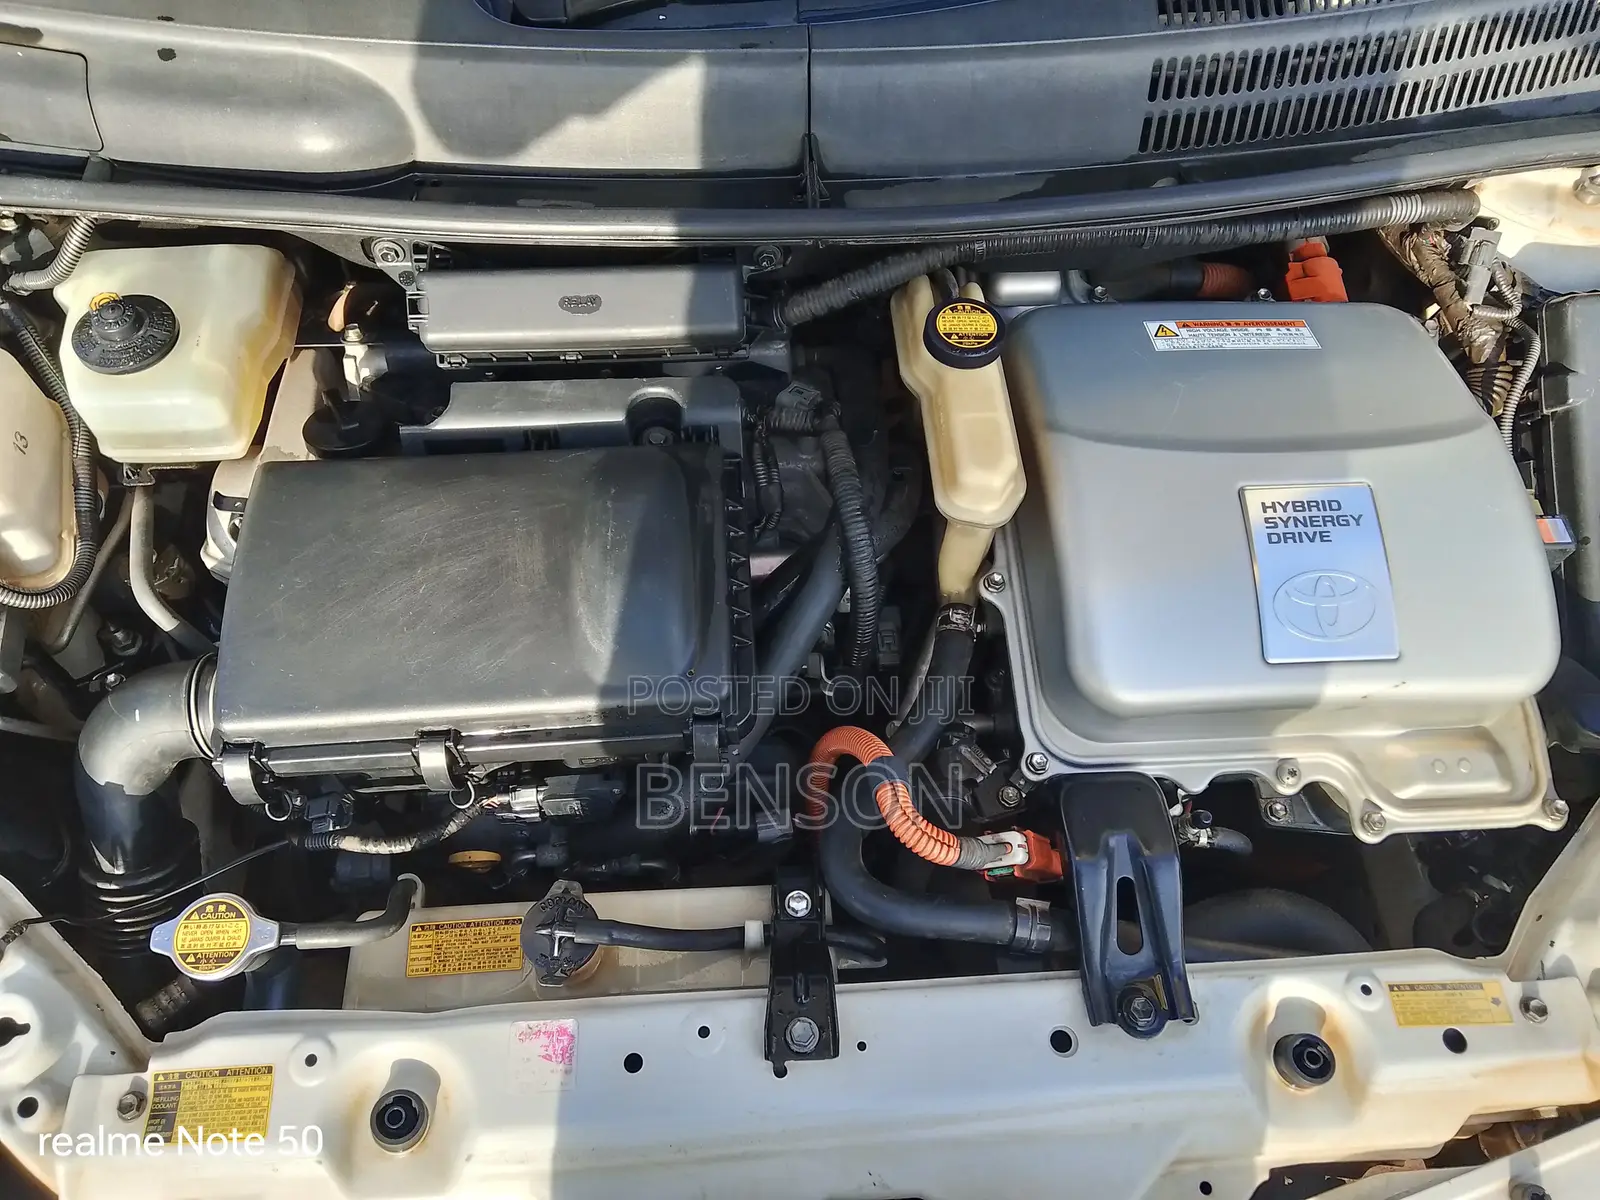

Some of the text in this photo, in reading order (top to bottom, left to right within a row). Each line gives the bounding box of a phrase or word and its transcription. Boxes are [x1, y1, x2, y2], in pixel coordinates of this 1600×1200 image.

[563, 296, 597, 308] RELAY
[1261, 500, 1342, 514] HYBRID
[1264, 514, 1363, 529] SYNERGY
[1267, 531, 1332, 545] DRIVE
[200, 912, 236, 920] CAUTION
[438, 922, 467, 930] CAUTION
[470, 920, 505, 928] ATTENTION
[196, 951, 235, 959] ATTENTION
[185, 1070, 220, 1079] CAUTION
[226, 1066, 269, 1076] ATTENTION
[151, 1102, 177, 1110] COOLANT
